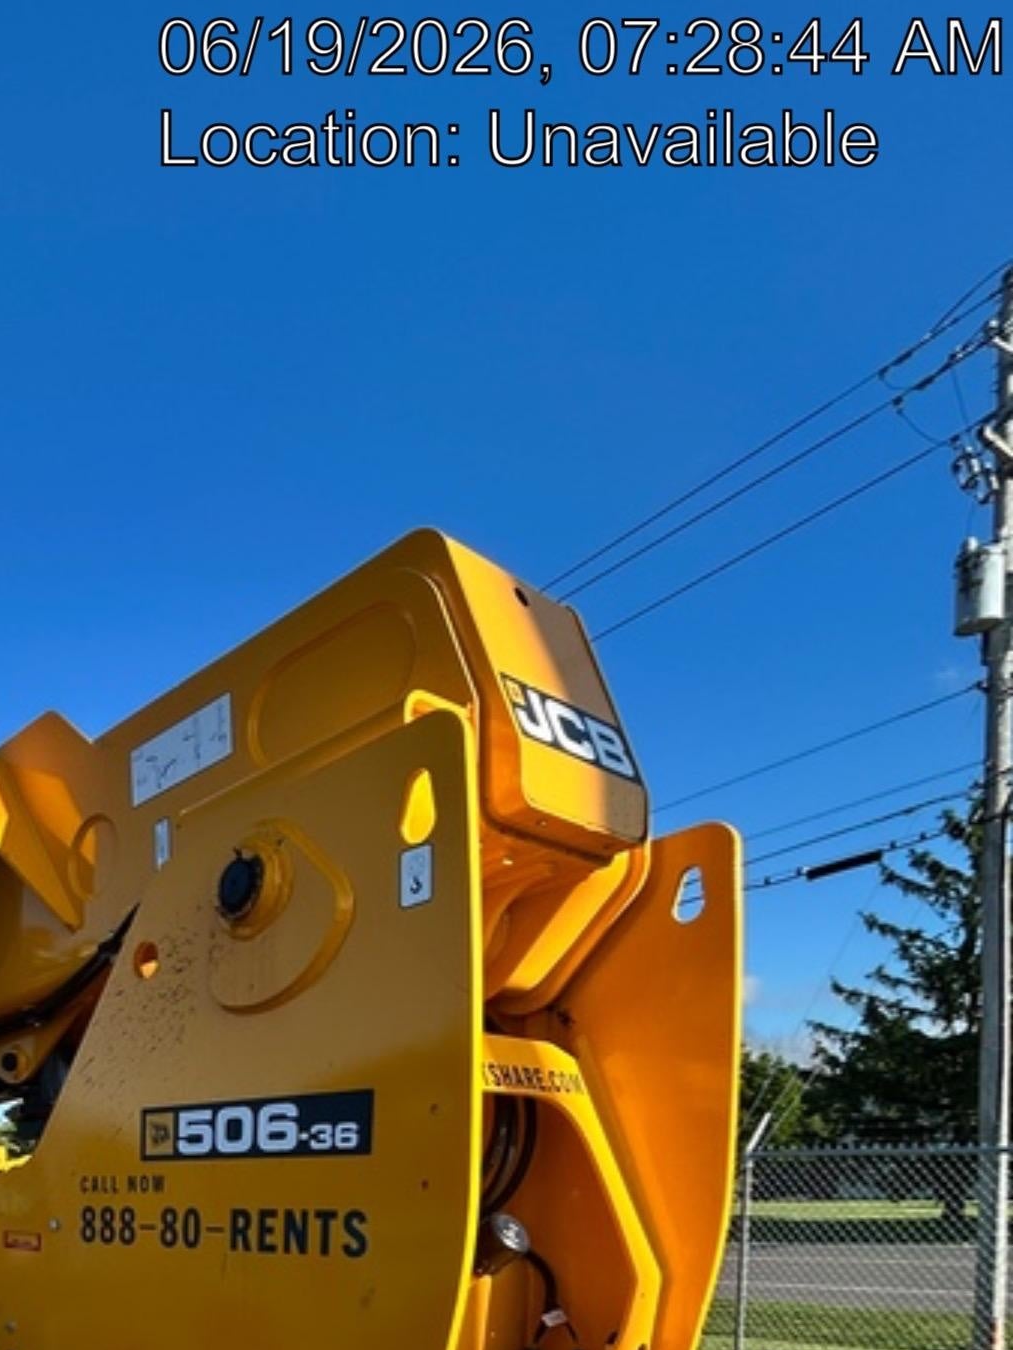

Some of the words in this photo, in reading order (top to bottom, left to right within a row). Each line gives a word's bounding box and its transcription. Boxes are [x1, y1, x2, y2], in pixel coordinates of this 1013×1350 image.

[514, 687, 635, 779] JCB
[176, 1102, 360, 1155] 506-36
[79, 1174, 119, 1195] CALL
[127, 1174, 166, 1194] NOW
[80, 1204, 370, 1259] 888-80-RENTS
